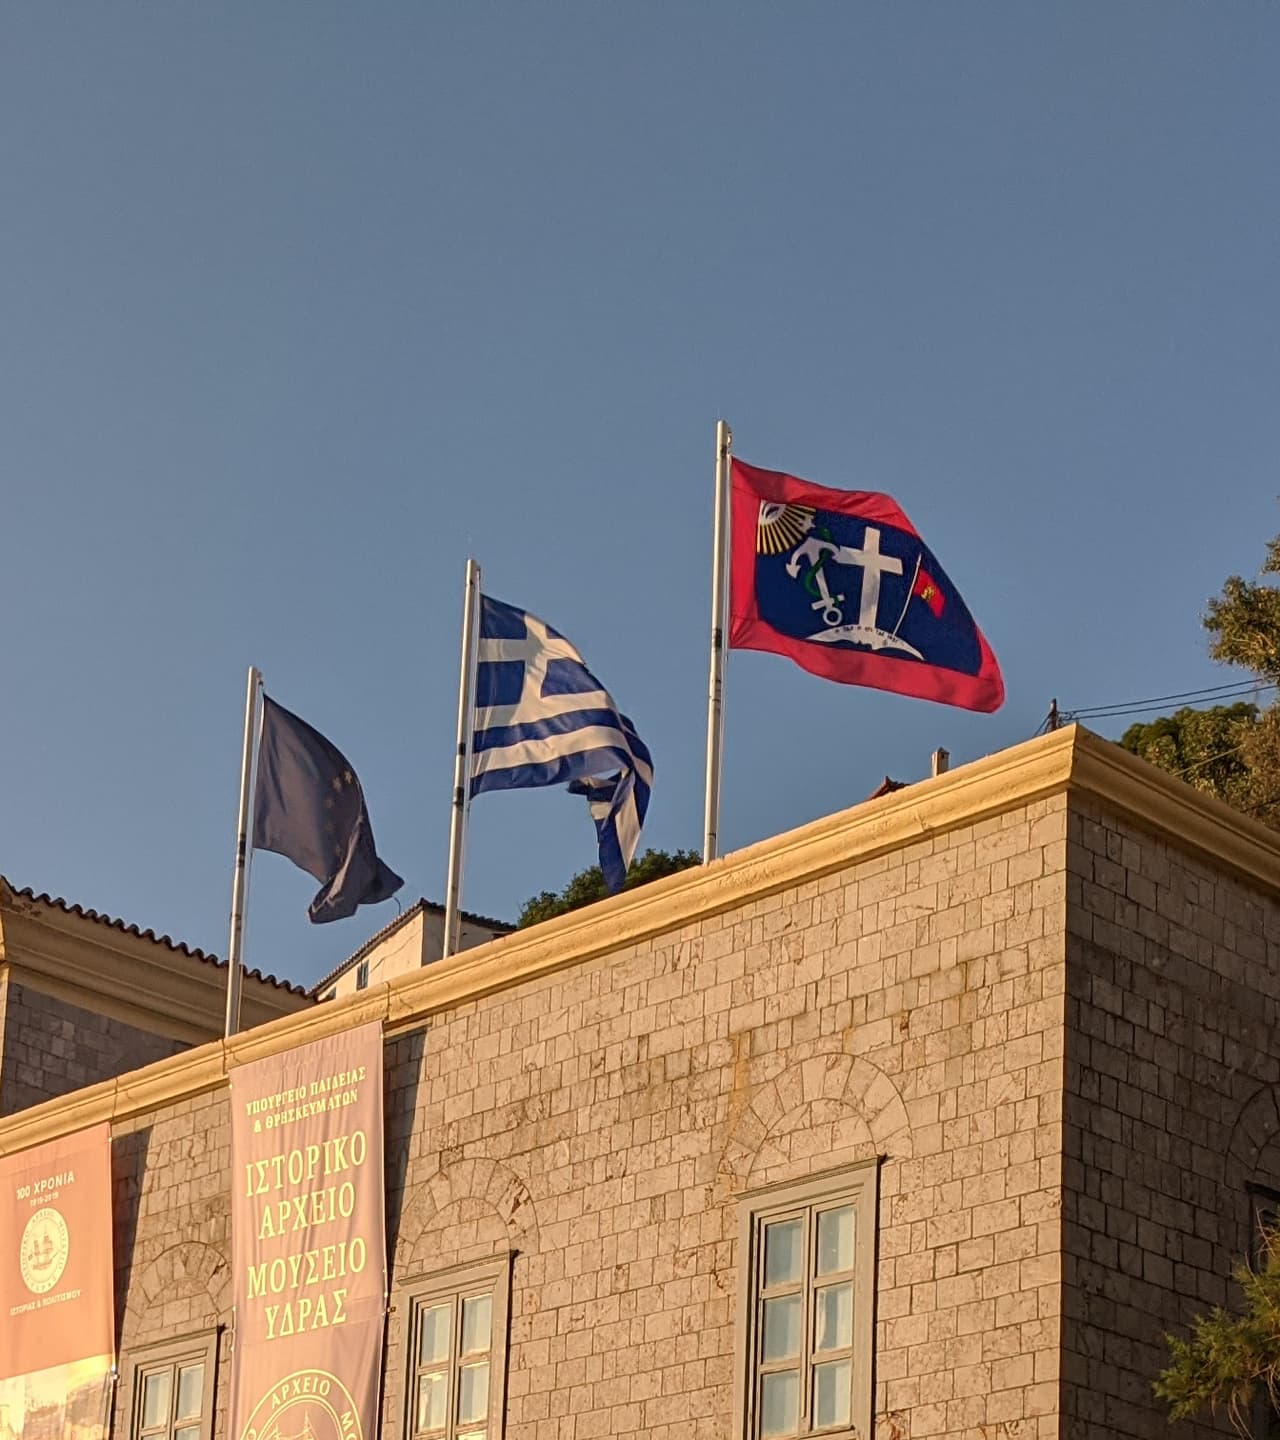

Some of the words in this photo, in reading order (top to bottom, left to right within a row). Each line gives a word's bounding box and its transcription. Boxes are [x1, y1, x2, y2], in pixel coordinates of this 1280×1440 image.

[246, 1086, 307, 1116] ΥΠΟΥΡΓΕΙΟ
[310, 1066, 366, 1096] ΠΑΙΔΕΙΑΣ
[253, 1119, 262, 1133] &
[265, 1088, 358, 1129] ΘΡΗΣΚΕΥΜΑΤΩΝ
[33, 1170, 75, 1196] ΧΡΟΝΙΑ
[245, 1130, 367, 1198] ΙΣΤΟΡΙΚΟ
[257, 1182, 356, 1241] ΑΡΧΕΙΟ
[246, 1237, 367, 1300] ΜΟΥΣΕΙΟ
[264, 1288, 348, 1340] ΥΔΡΑΣ
[270, 1376, 332, 1410] ΑΡΧΕΙΟ
